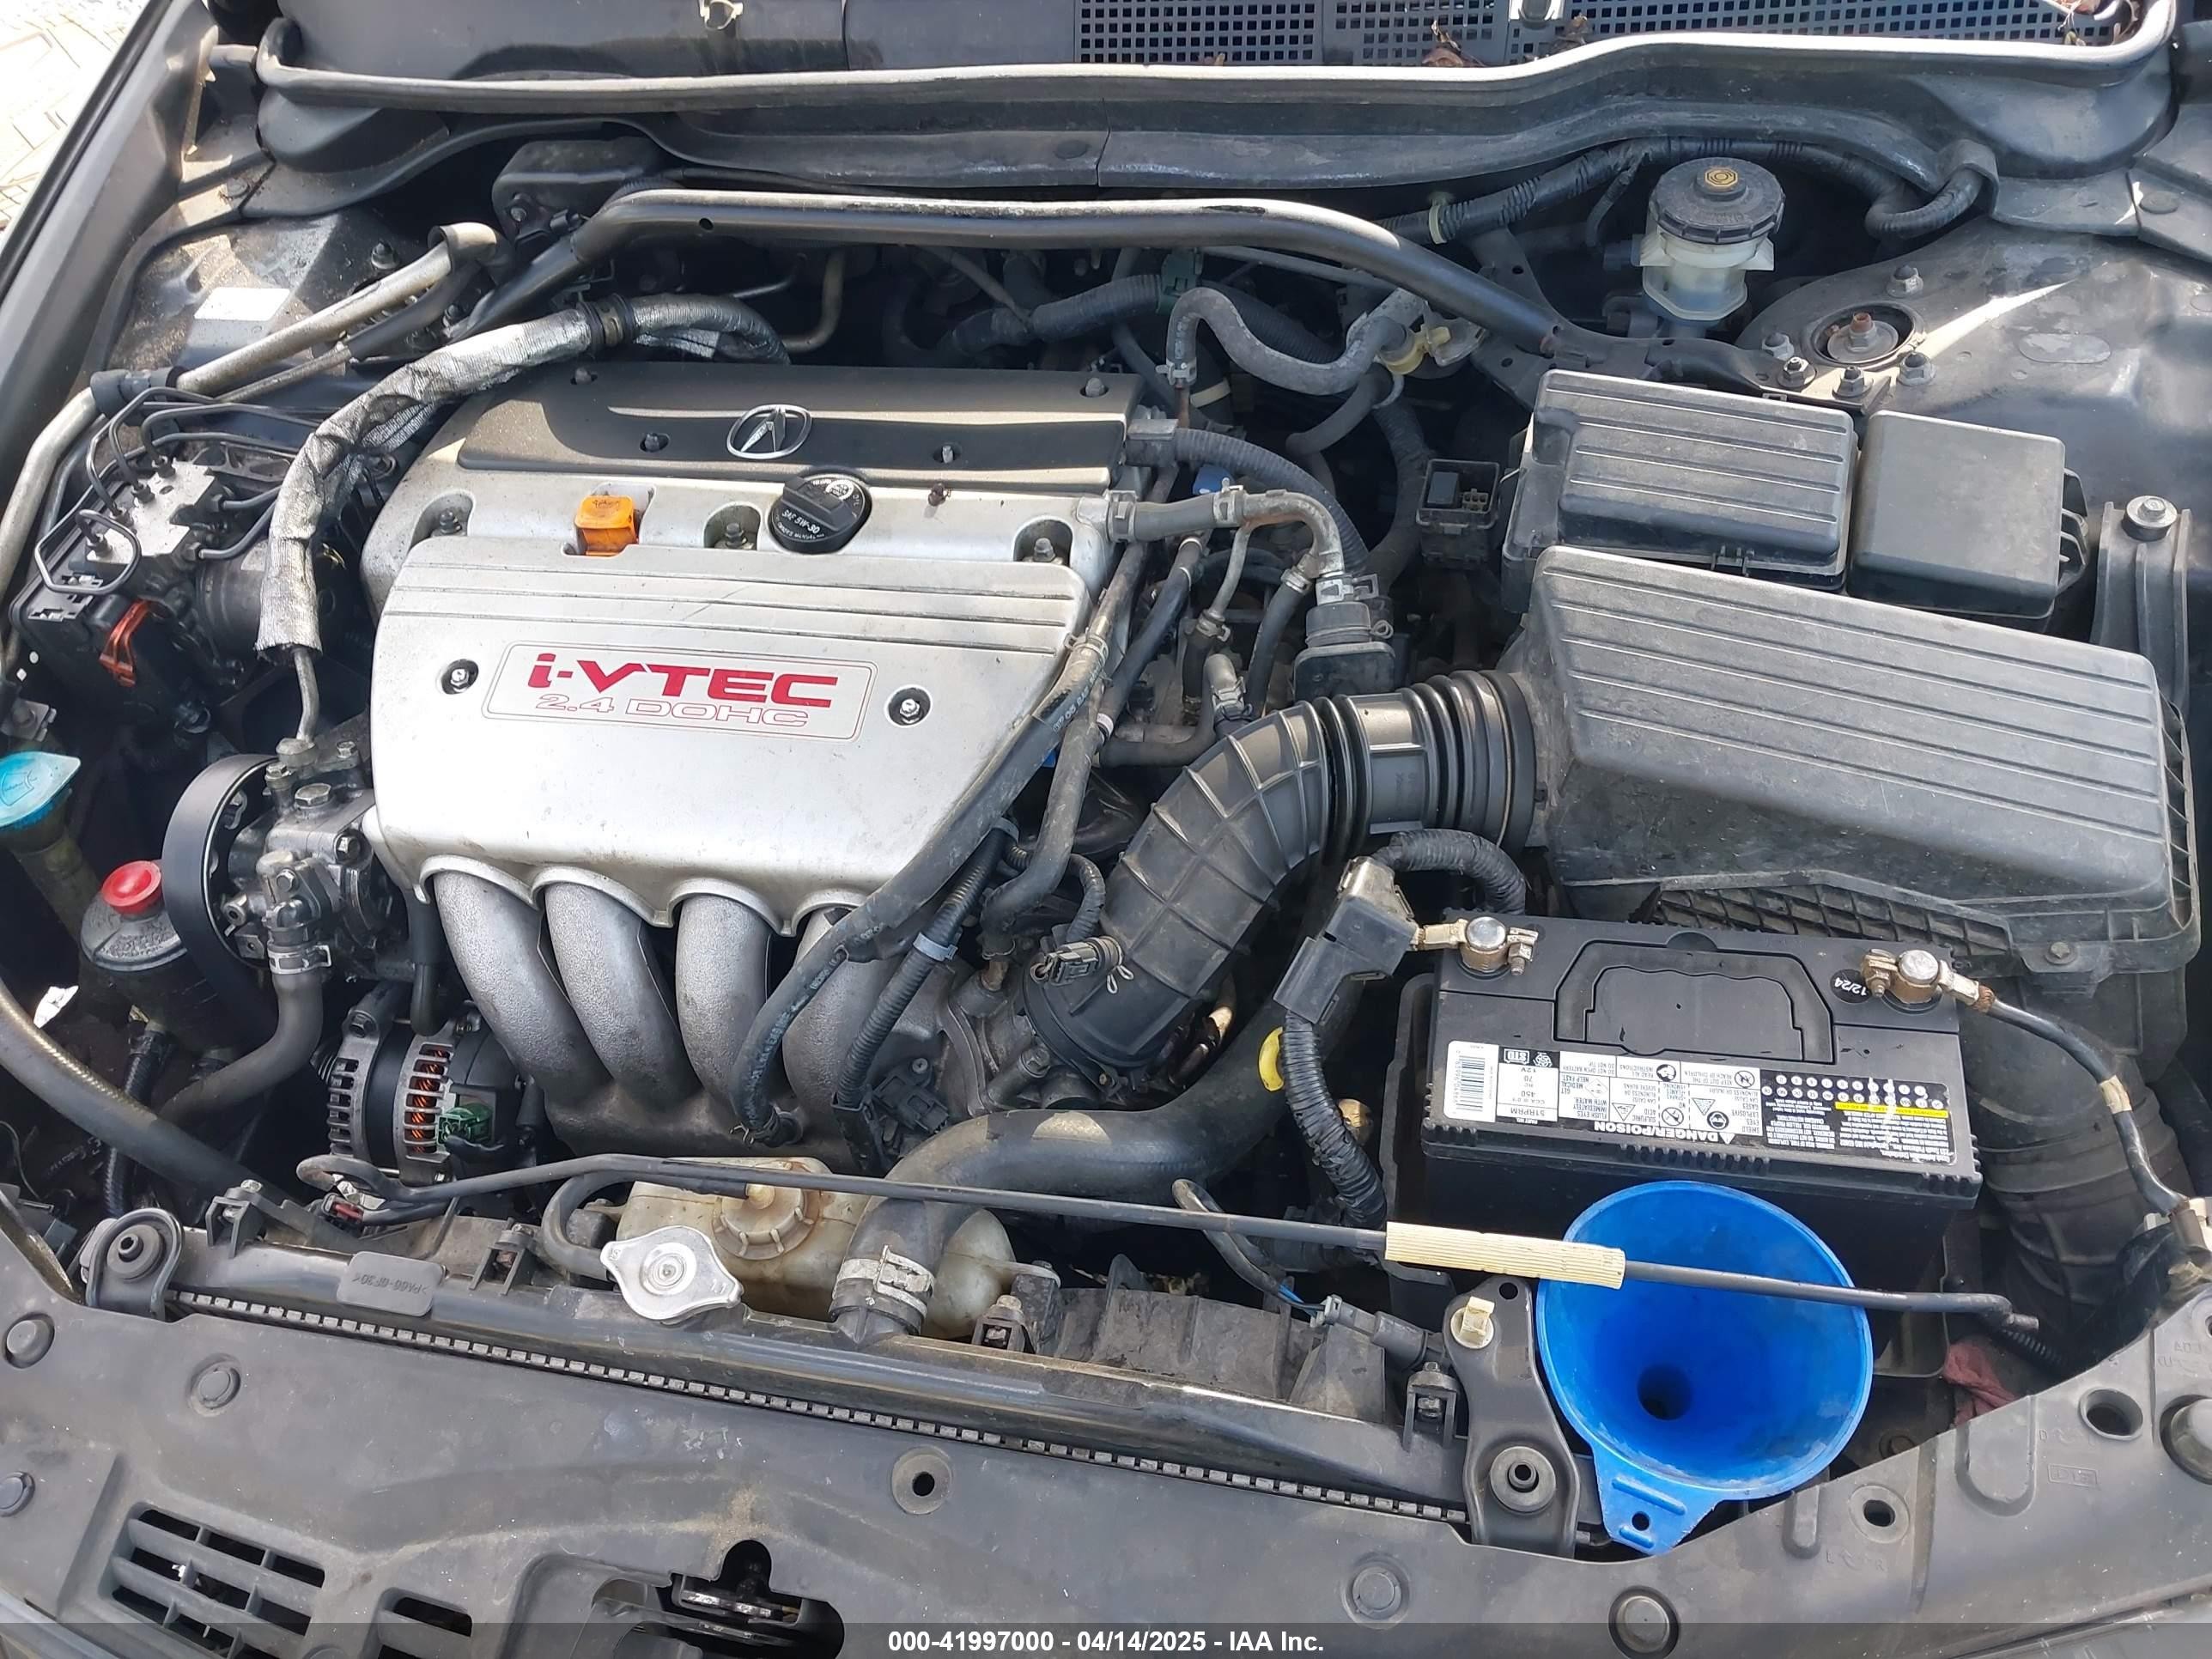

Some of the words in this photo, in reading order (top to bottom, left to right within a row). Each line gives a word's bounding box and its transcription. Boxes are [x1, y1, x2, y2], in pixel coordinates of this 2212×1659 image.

[781, 509, 796, 521] SAE
[794, 516, 820, 534] 5W-30
[527, 653, 838, 708] i-VTEC
[535, 693, 615, 713] 2.4
[625, 697, 808, 726] DOHC
[1834, 977, 1867, 996] 12/24
[1510, 1107, 1545, 1116] 51RPRM
[1594, 1121, 1719, 1141] DANGER/POISON
[1741, 1125, 1759, 1133] SHIELD
